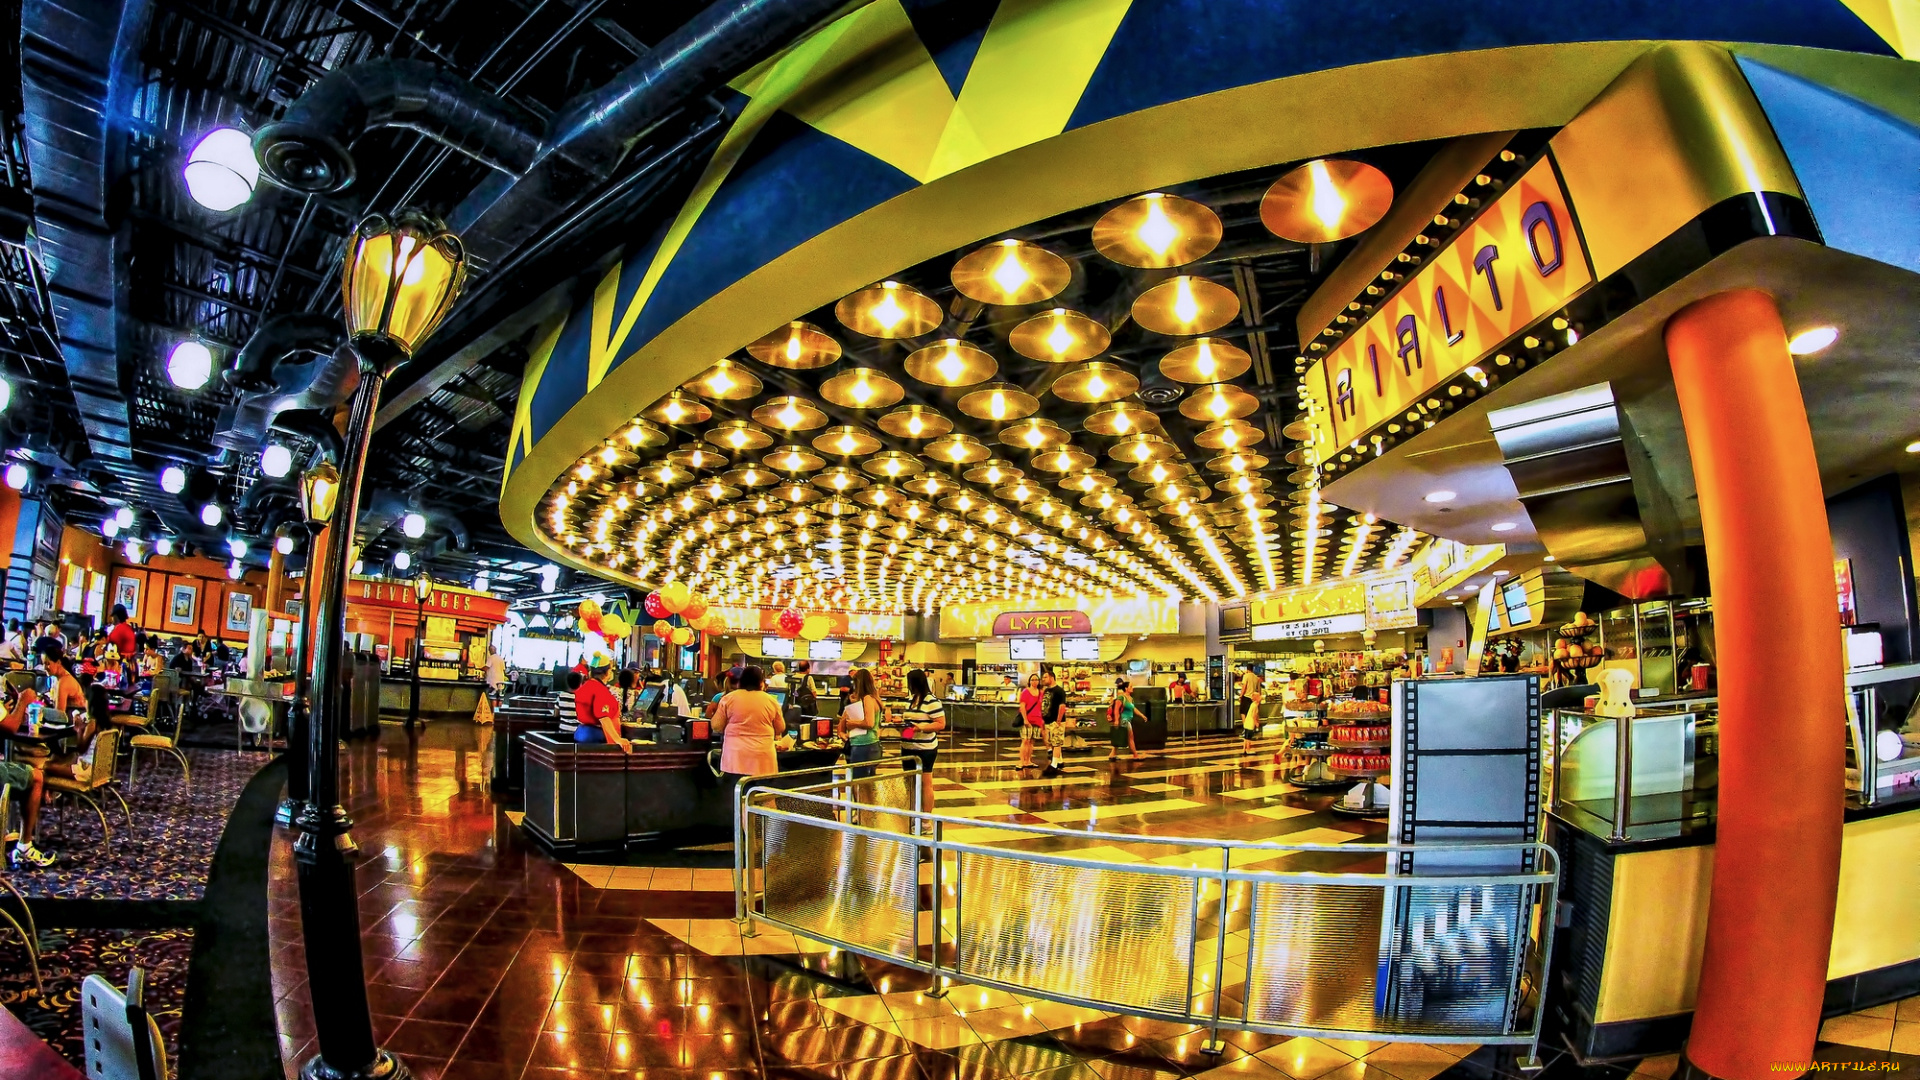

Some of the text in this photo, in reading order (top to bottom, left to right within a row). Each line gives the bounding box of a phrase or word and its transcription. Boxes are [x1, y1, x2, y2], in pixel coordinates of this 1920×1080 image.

[1336, 201, 1562, 421] RIALTO
[363, 584, 471, 611] BEVEAGES
[1010, 616, 1073, 630] LYRIC
